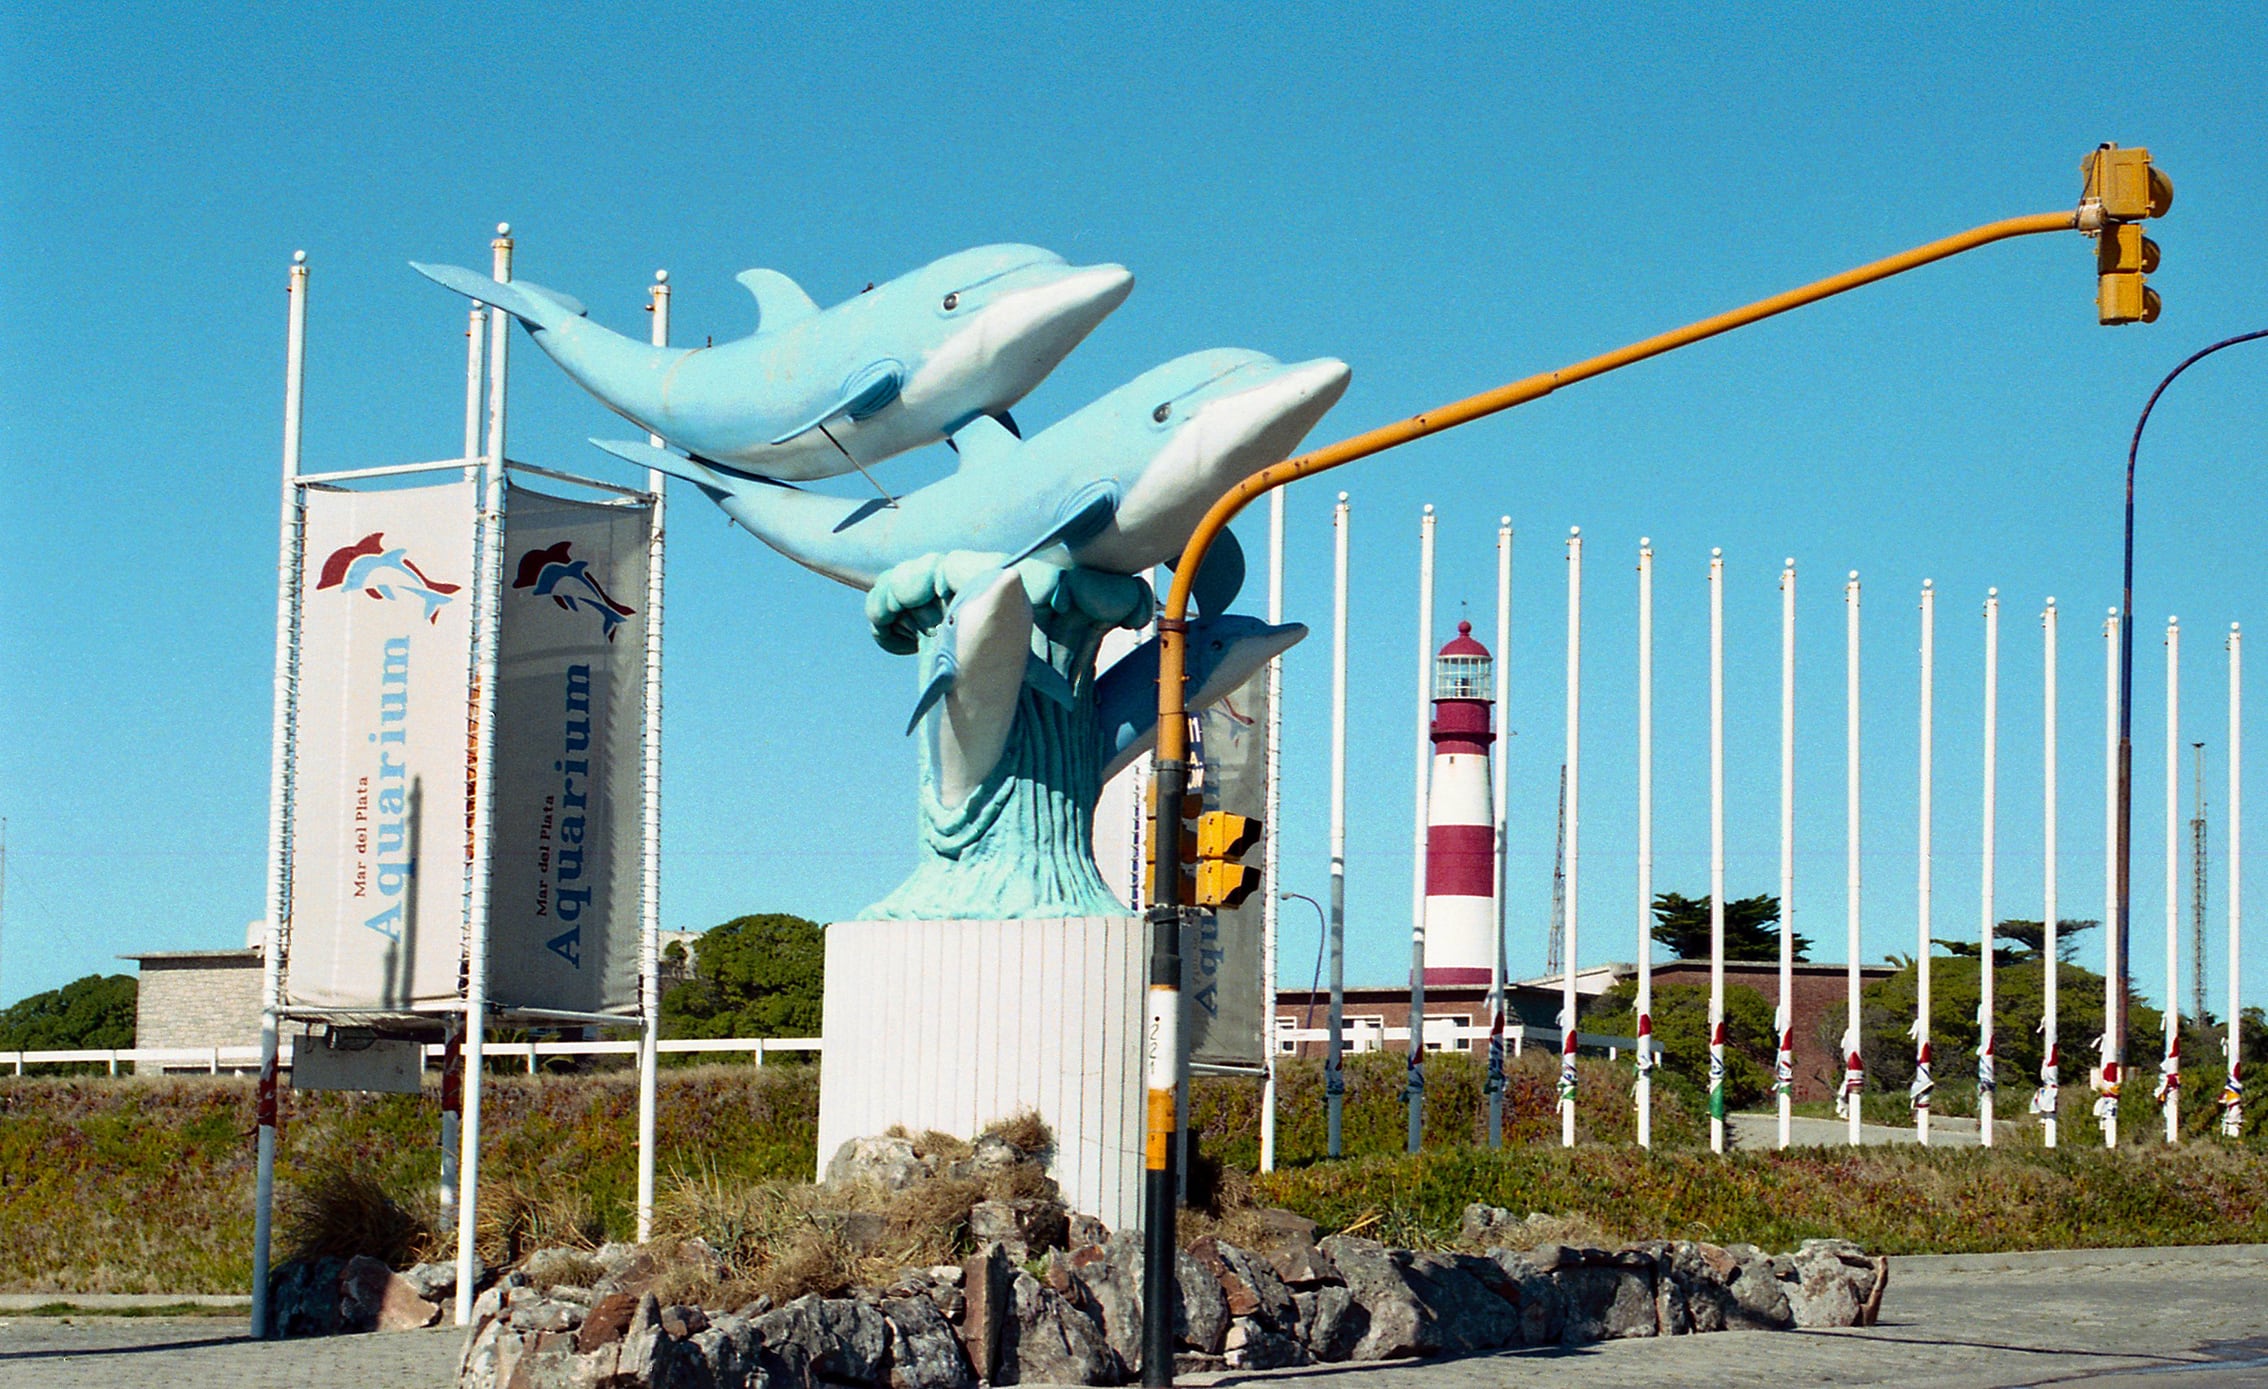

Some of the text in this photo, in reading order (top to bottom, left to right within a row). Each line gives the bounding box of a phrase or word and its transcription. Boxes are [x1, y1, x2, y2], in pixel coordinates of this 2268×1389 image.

[353, 776, 369, 898] Mar del Plata
[365, 635, 415, 943] Aquarium
[535, 795, 555, 917] Mar del Plata
[544, 663, 593, 970] Aquarium
